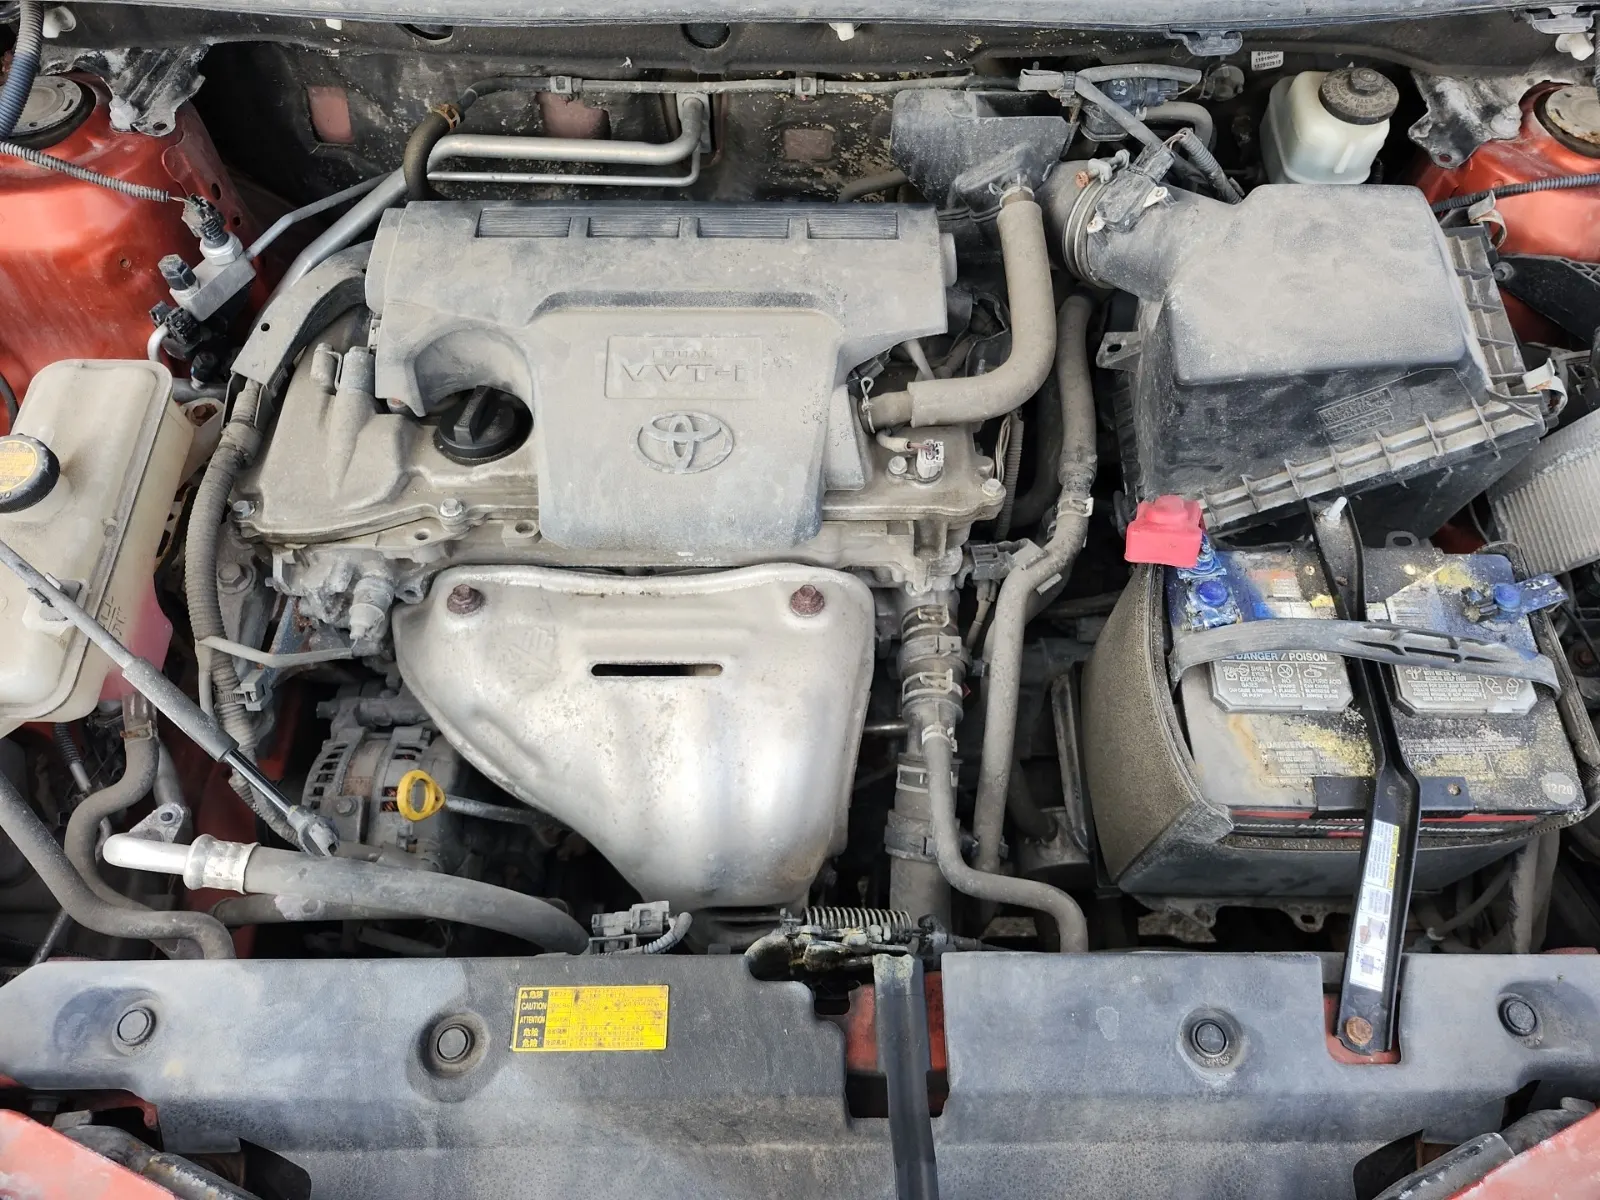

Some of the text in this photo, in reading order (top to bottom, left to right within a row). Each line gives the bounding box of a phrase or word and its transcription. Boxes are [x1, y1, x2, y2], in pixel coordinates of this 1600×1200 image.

[1236, 652, 1278, 661] DANGER
[1288, 652, 1328, 662] POISON
[520, 1002, 547, 1010] CAUTION
[520, 1015, 546, 1024] ATTENTION
